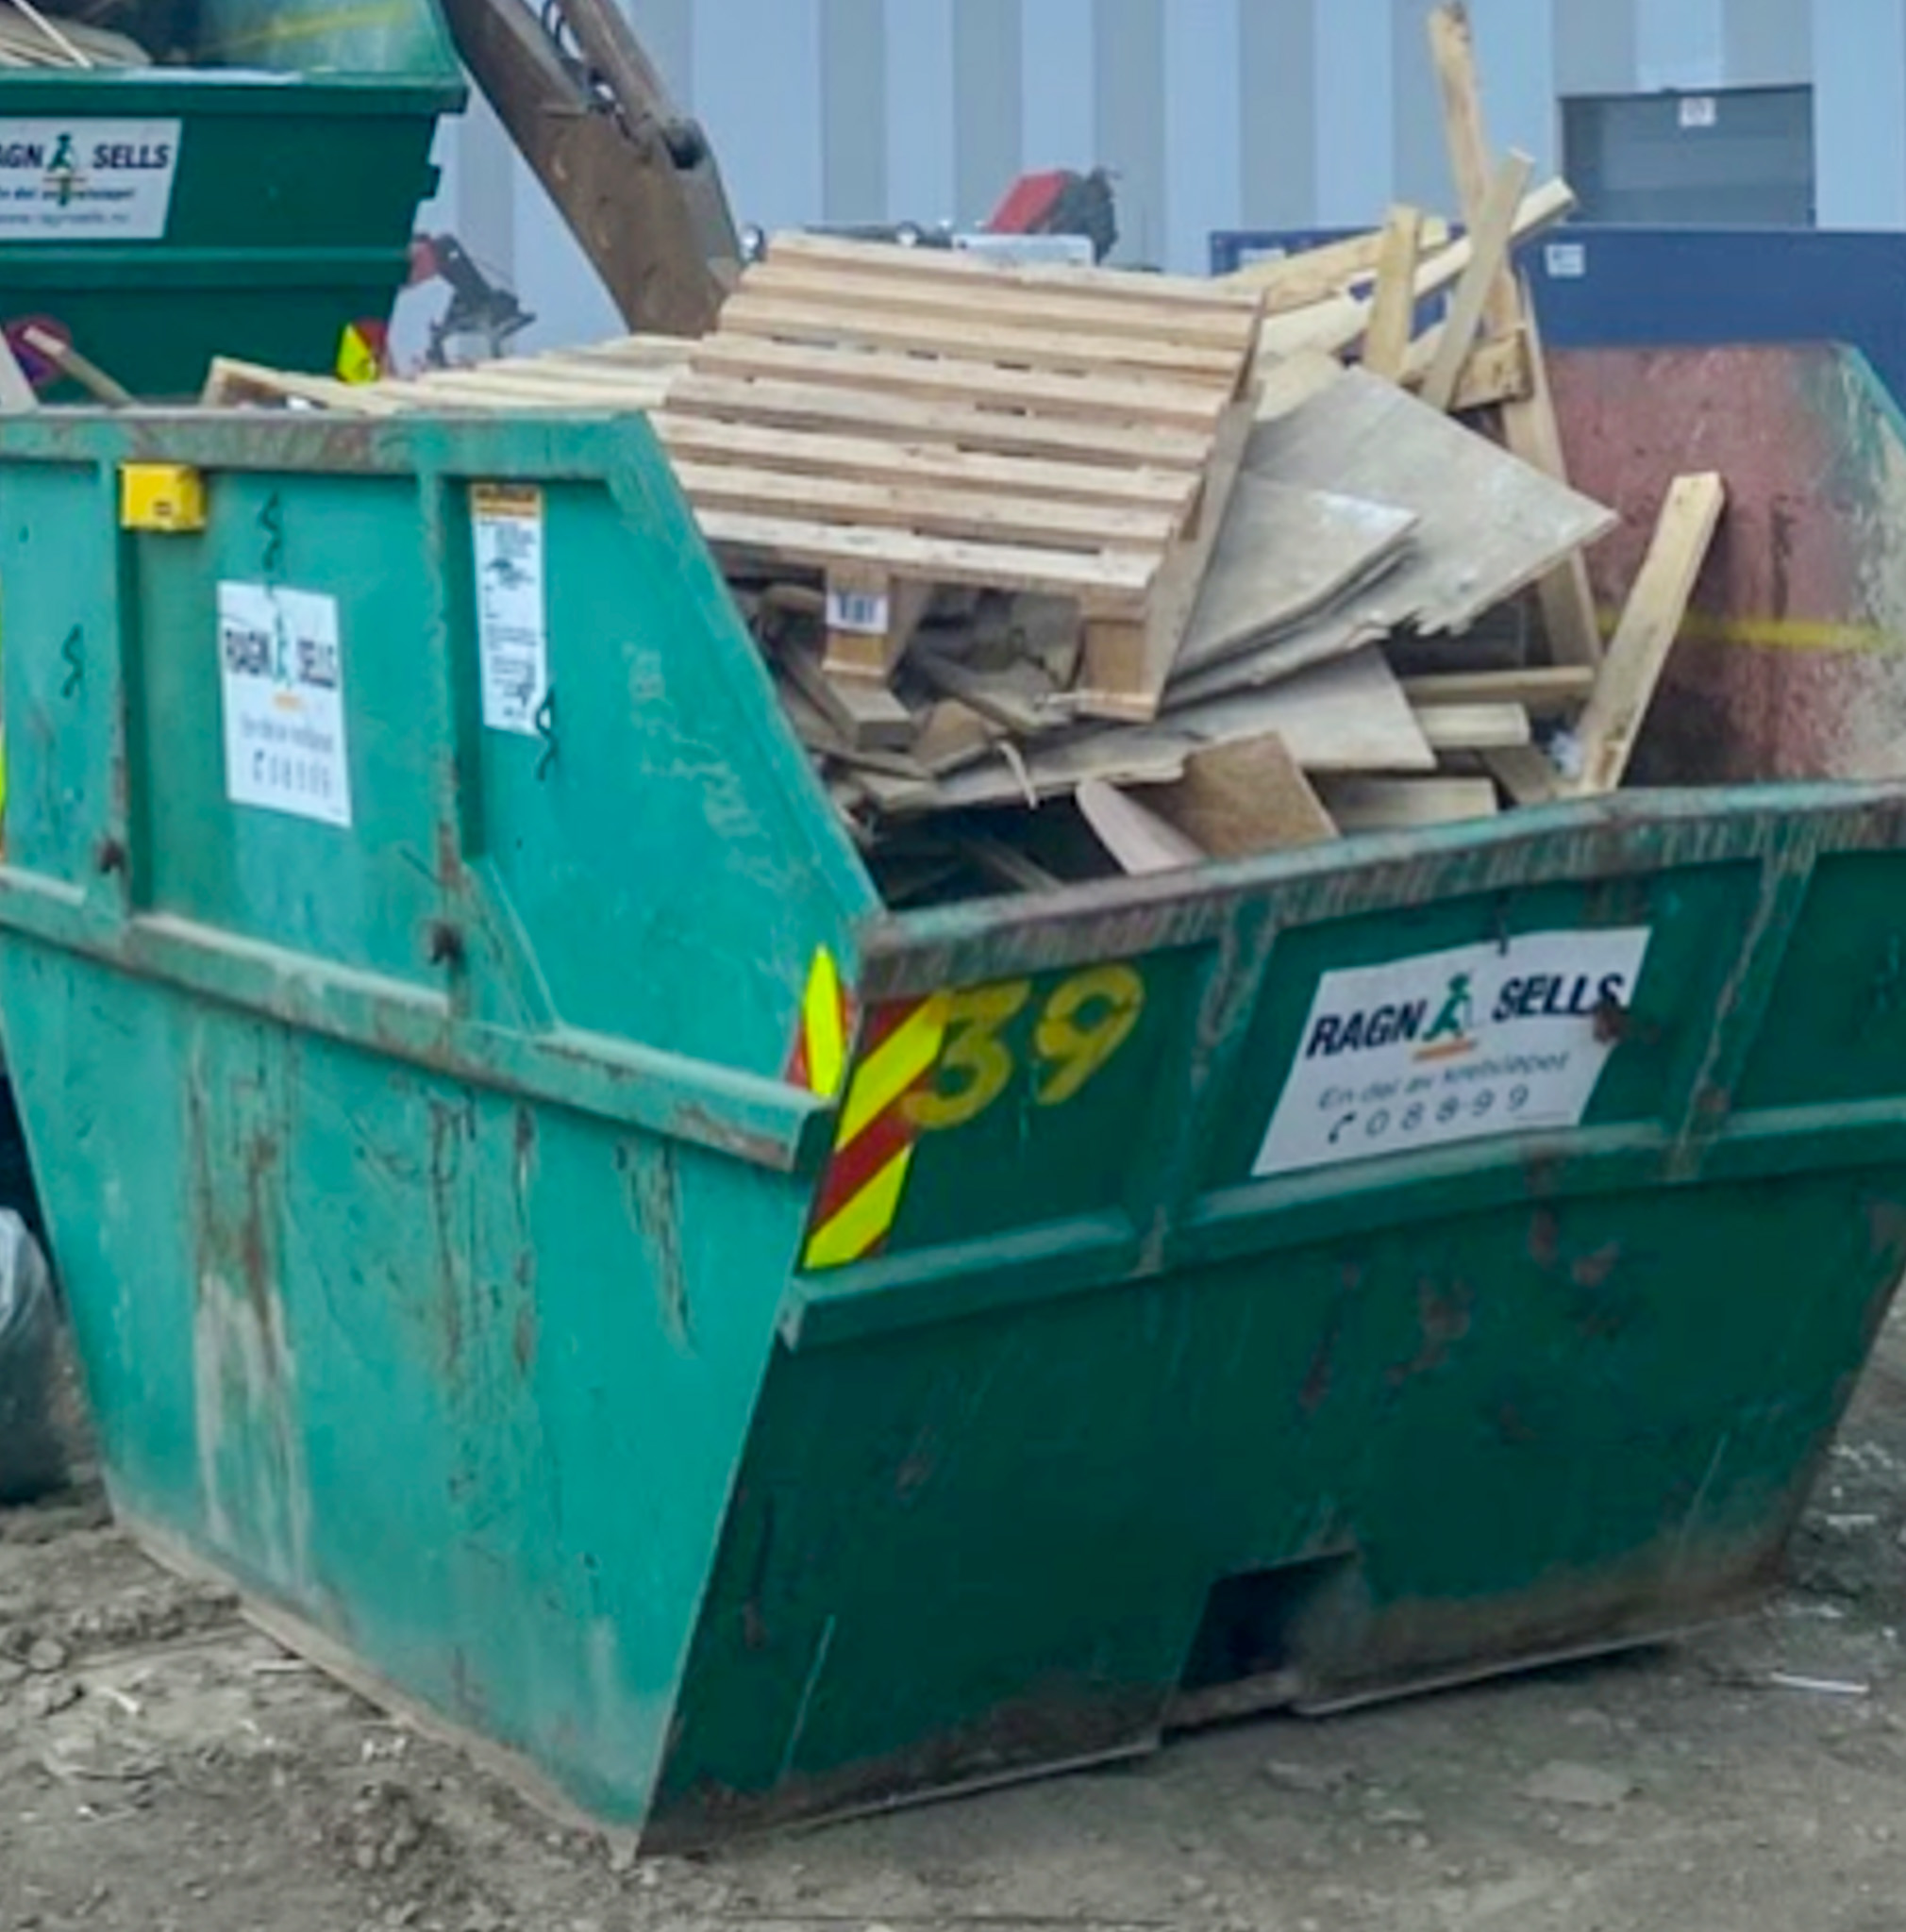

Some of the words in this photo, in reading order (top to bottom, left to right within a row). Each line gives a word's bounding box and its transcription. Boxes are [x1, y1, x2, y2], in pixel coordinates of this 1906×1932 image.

[92, 143, 170, 169] SELLS
[902, 963, 1145, 1129] 39
[1305, 998, 1428, 1060] RAGN
[1491, 973, 1626, 1024] SELLS
